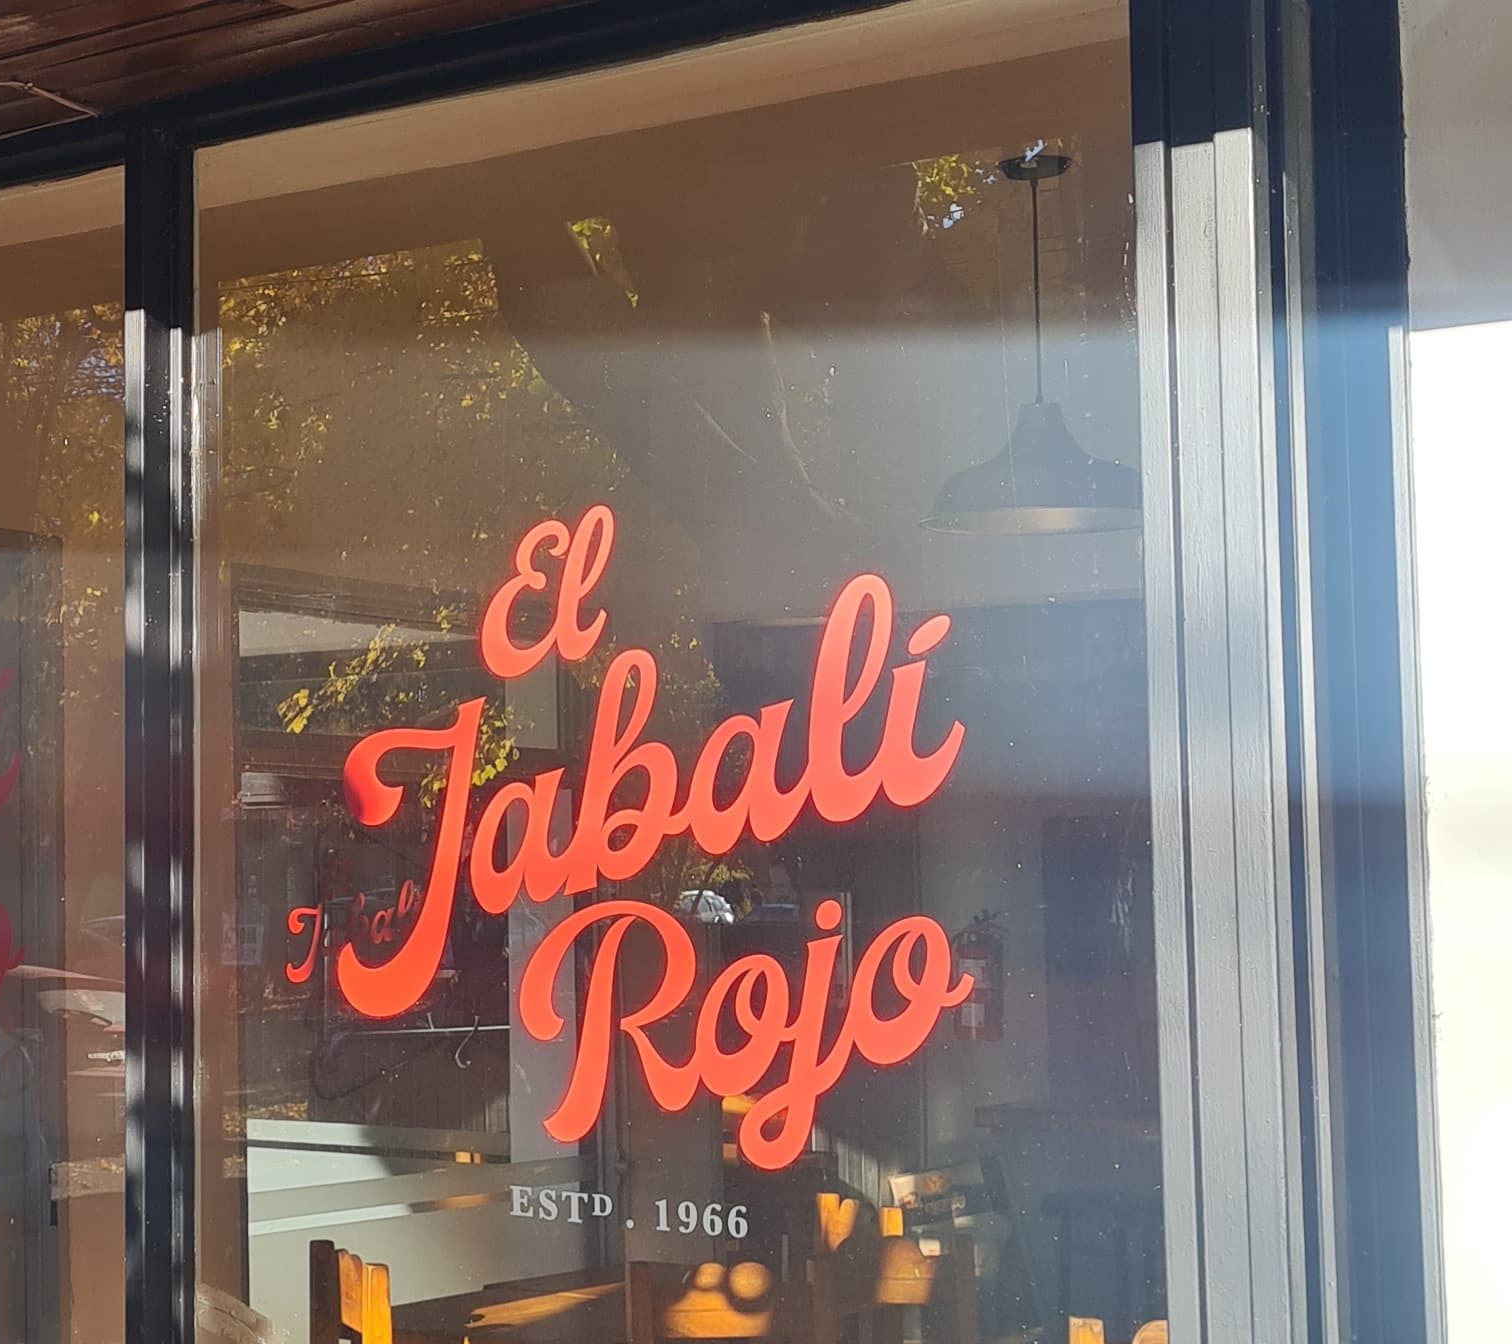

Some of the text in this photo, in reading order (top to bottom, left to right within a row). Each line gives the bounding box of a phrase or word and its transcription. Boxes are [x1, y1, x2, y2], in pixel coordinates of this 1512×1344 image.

[480, 504, 616, 680] El
[518, 899, 976, 1172] Rojo
[654, 1198, 750, 1239] 1966
